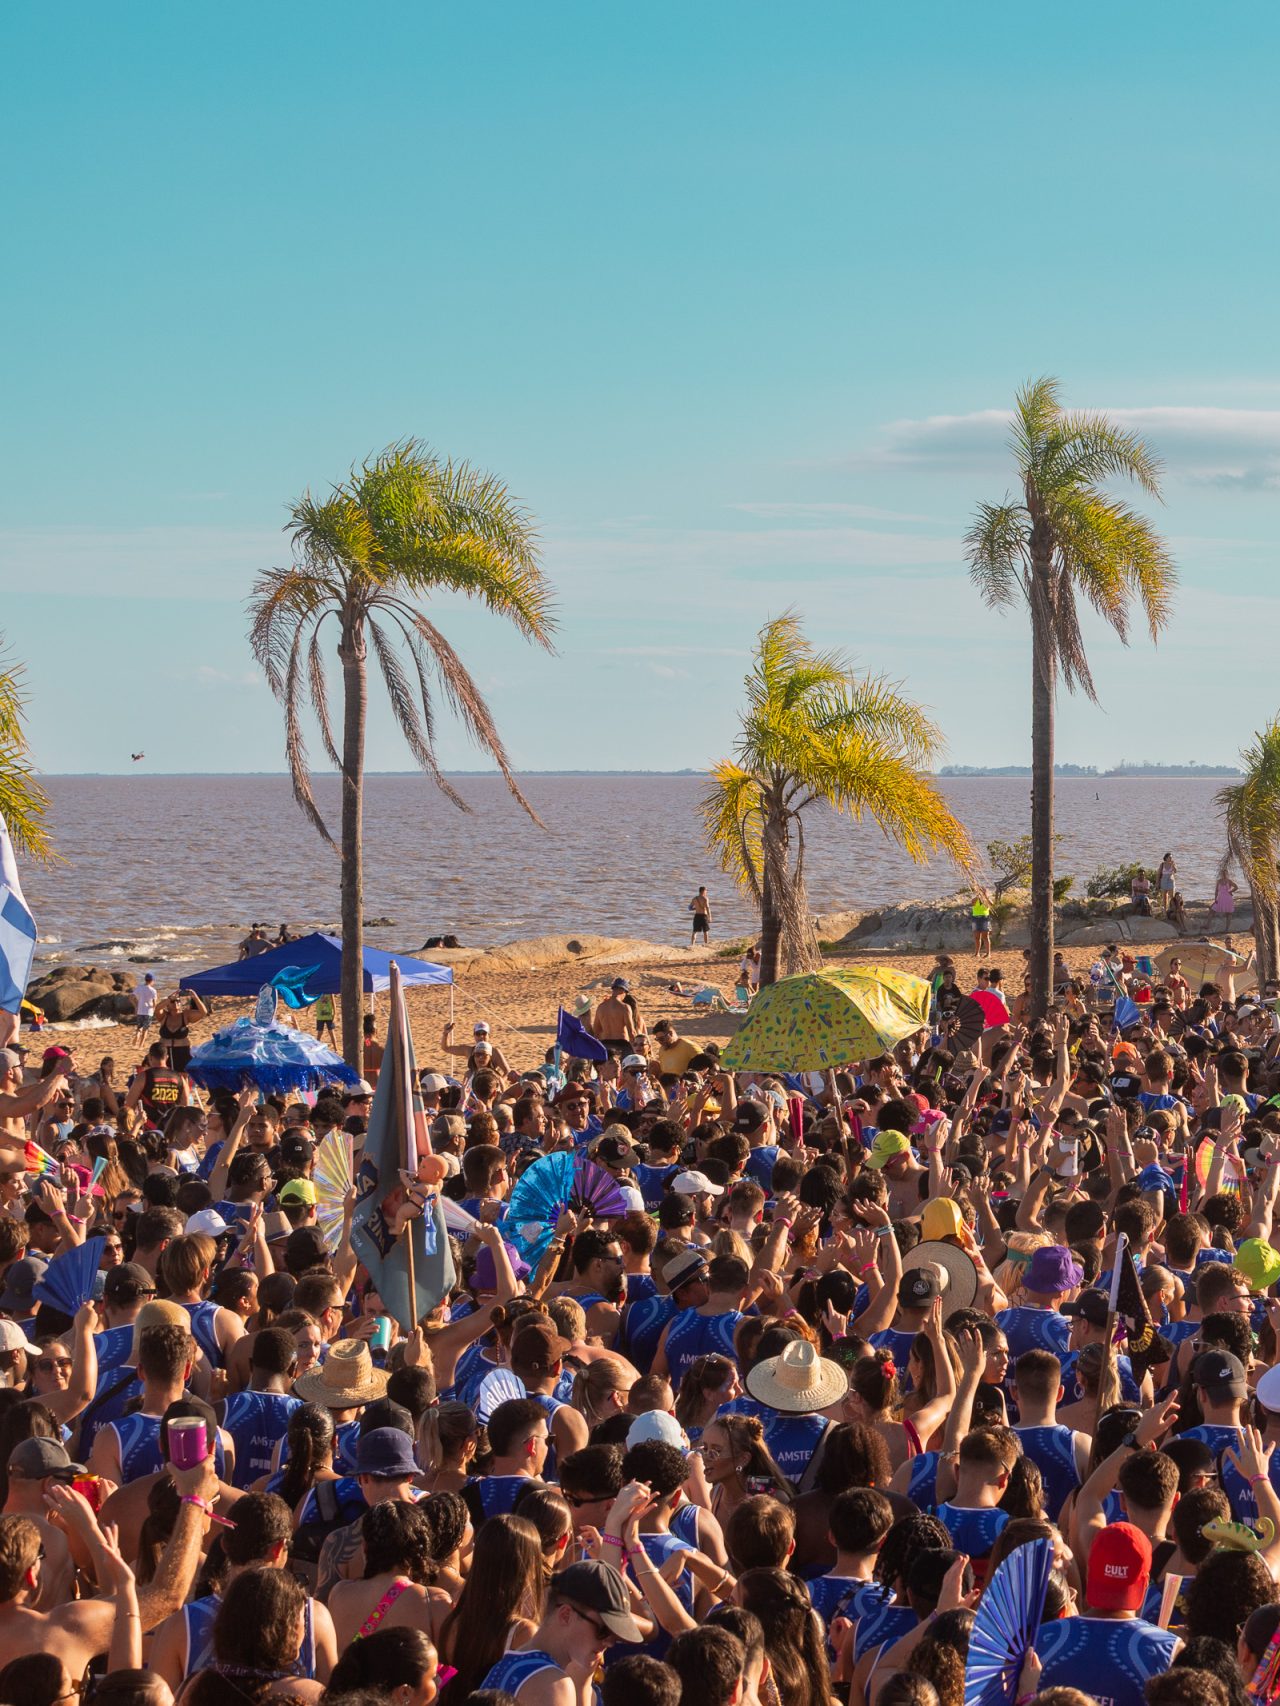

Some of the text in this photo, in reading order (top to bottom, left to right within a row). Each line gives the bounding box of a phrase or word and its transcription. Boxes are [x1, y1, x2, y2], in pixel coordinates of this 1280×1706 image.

[152, 1087, 179, 1101] 2026
[777, 1450, 813, 1462] AMSTE
[1104, 1563, 1129, 1576] CULT
